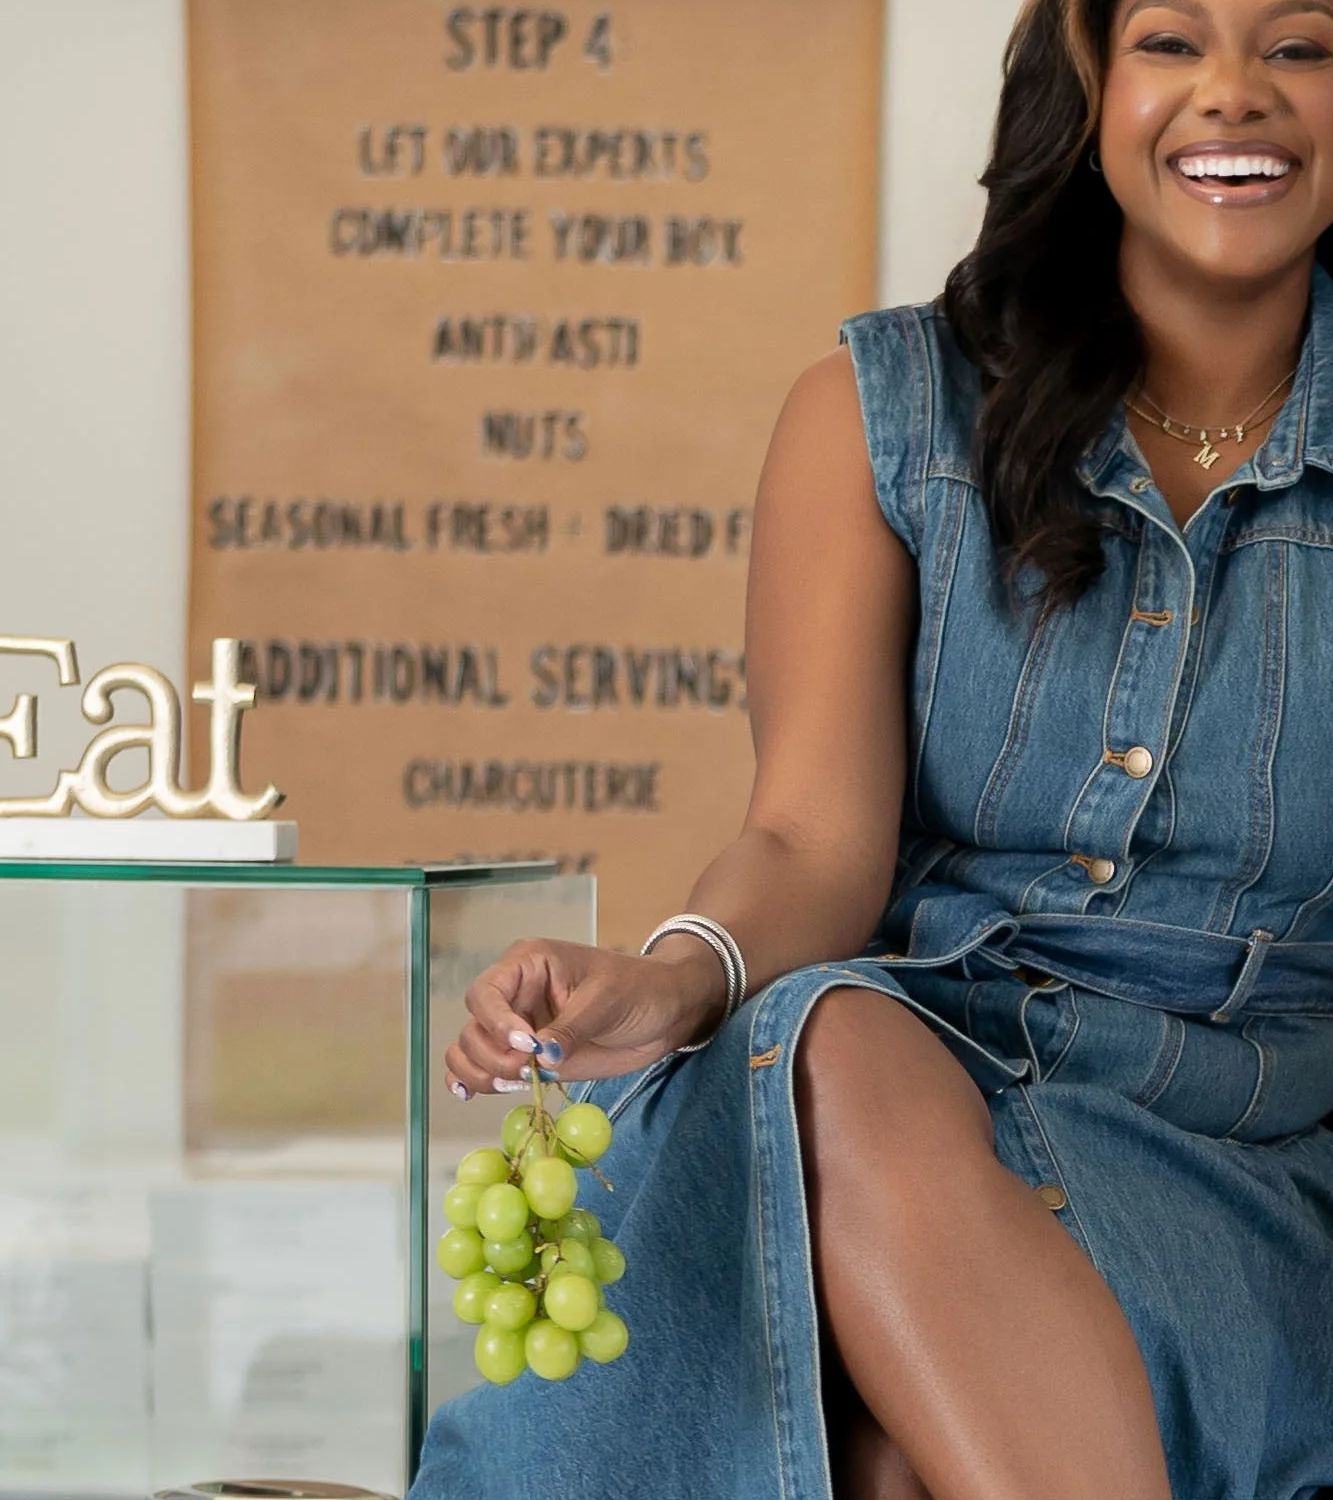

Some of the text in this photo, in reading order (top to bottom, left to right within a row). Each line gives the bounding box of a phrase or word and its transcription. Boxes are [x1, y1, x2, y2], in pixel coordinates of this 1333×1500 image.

[445, 6, 612, 71] STEP 4
[358, 124, 426, 177] LET
[533, 126, 710, 181] EXPERTS
[329, 208, 742, 267] COMPLETE YOUR BOX
[481, 410, 589, 461] NUTS
[208, 497, 414, 553] SEASONAL
[425, 503, 550, 553] FRESH
[606, 505, 714, 558] DRIED
[240, 640, 508, 706] ADDITIONAL
[402, 761, 662, 813] CHARCUTERIE
